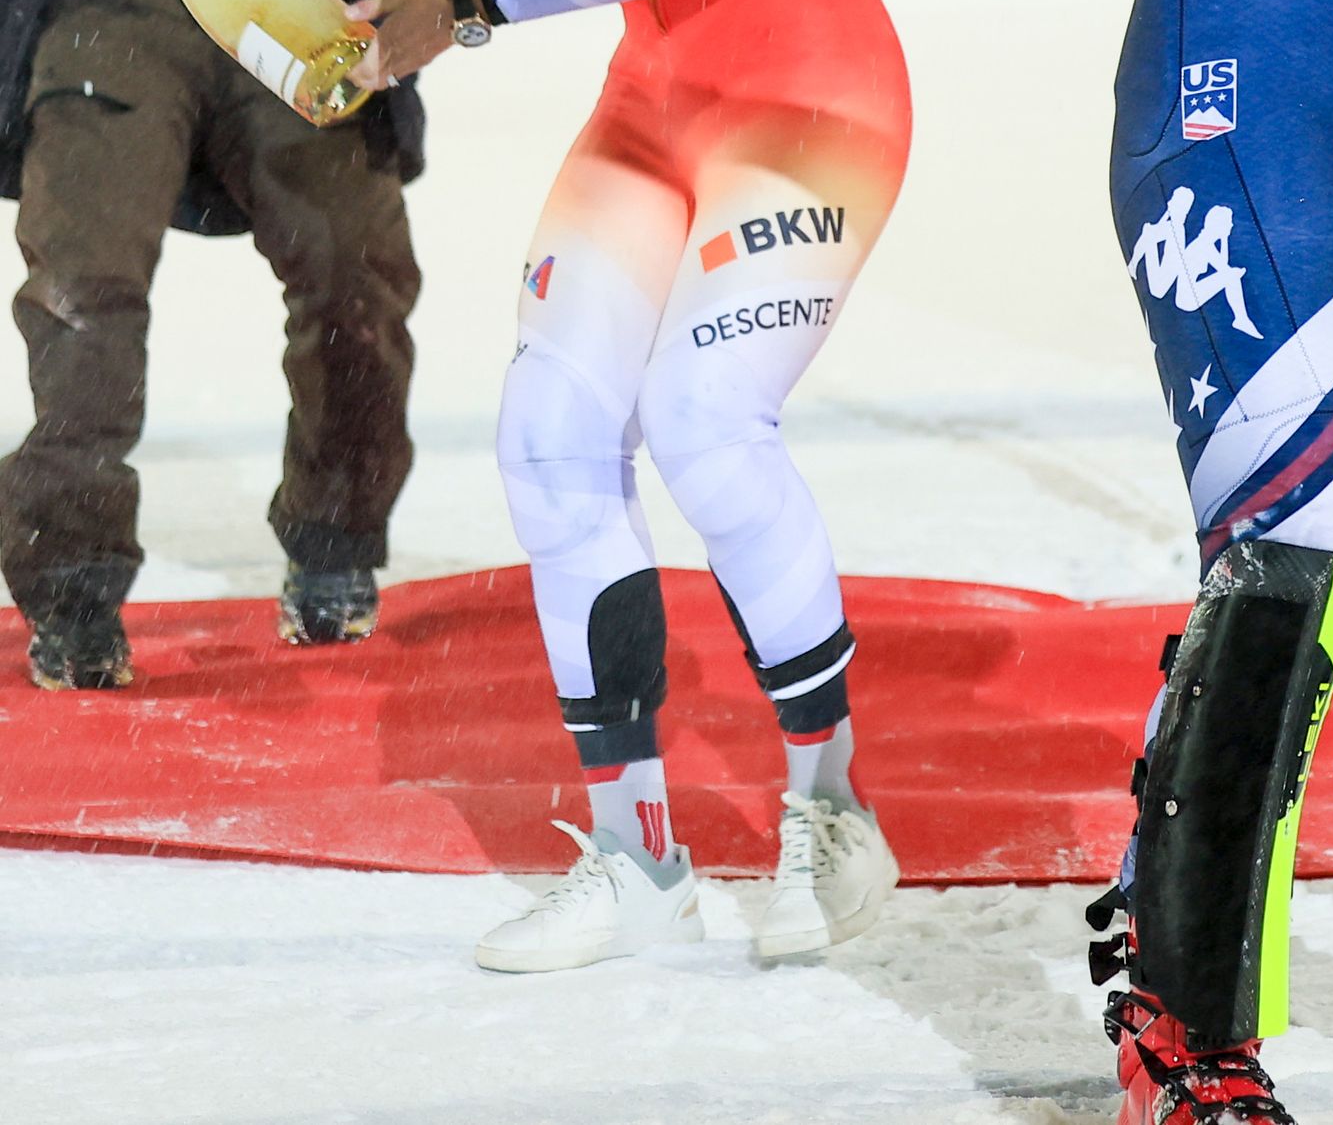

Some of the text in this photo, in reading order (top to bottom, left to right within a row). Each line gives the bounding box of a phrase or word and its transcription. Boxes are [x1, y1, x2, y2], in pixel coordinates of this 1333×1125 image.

[1183, 61, 1236, 90] US
[740, 207, 845, 255] BKW
[692, 298, 833, 349] DESCENTE
